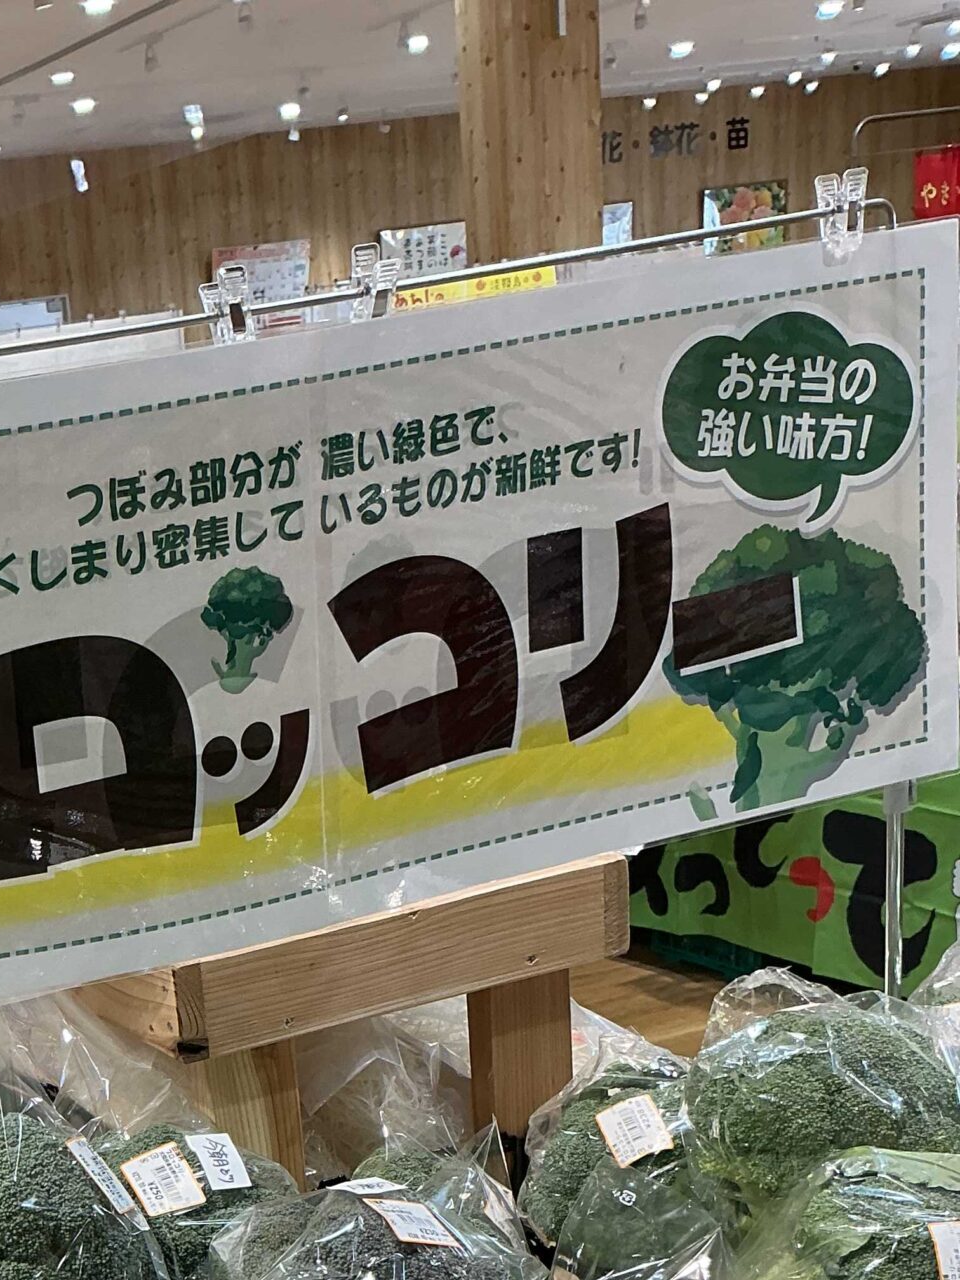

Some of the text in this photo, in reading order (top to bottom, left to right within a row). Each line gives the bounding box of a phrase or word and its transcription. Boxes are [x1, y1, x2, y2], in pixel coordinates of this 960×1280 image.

[716, 351, 878, 403] お弁当の
[697, 411, 872, 464] 強い味方!
[66, 408, 511, 527] つぼみ部分が 濃い緑色で、
[321, 428, 641, 534] いるものが新鮮です!
[147, 1181, 163, 1200] ¥250
